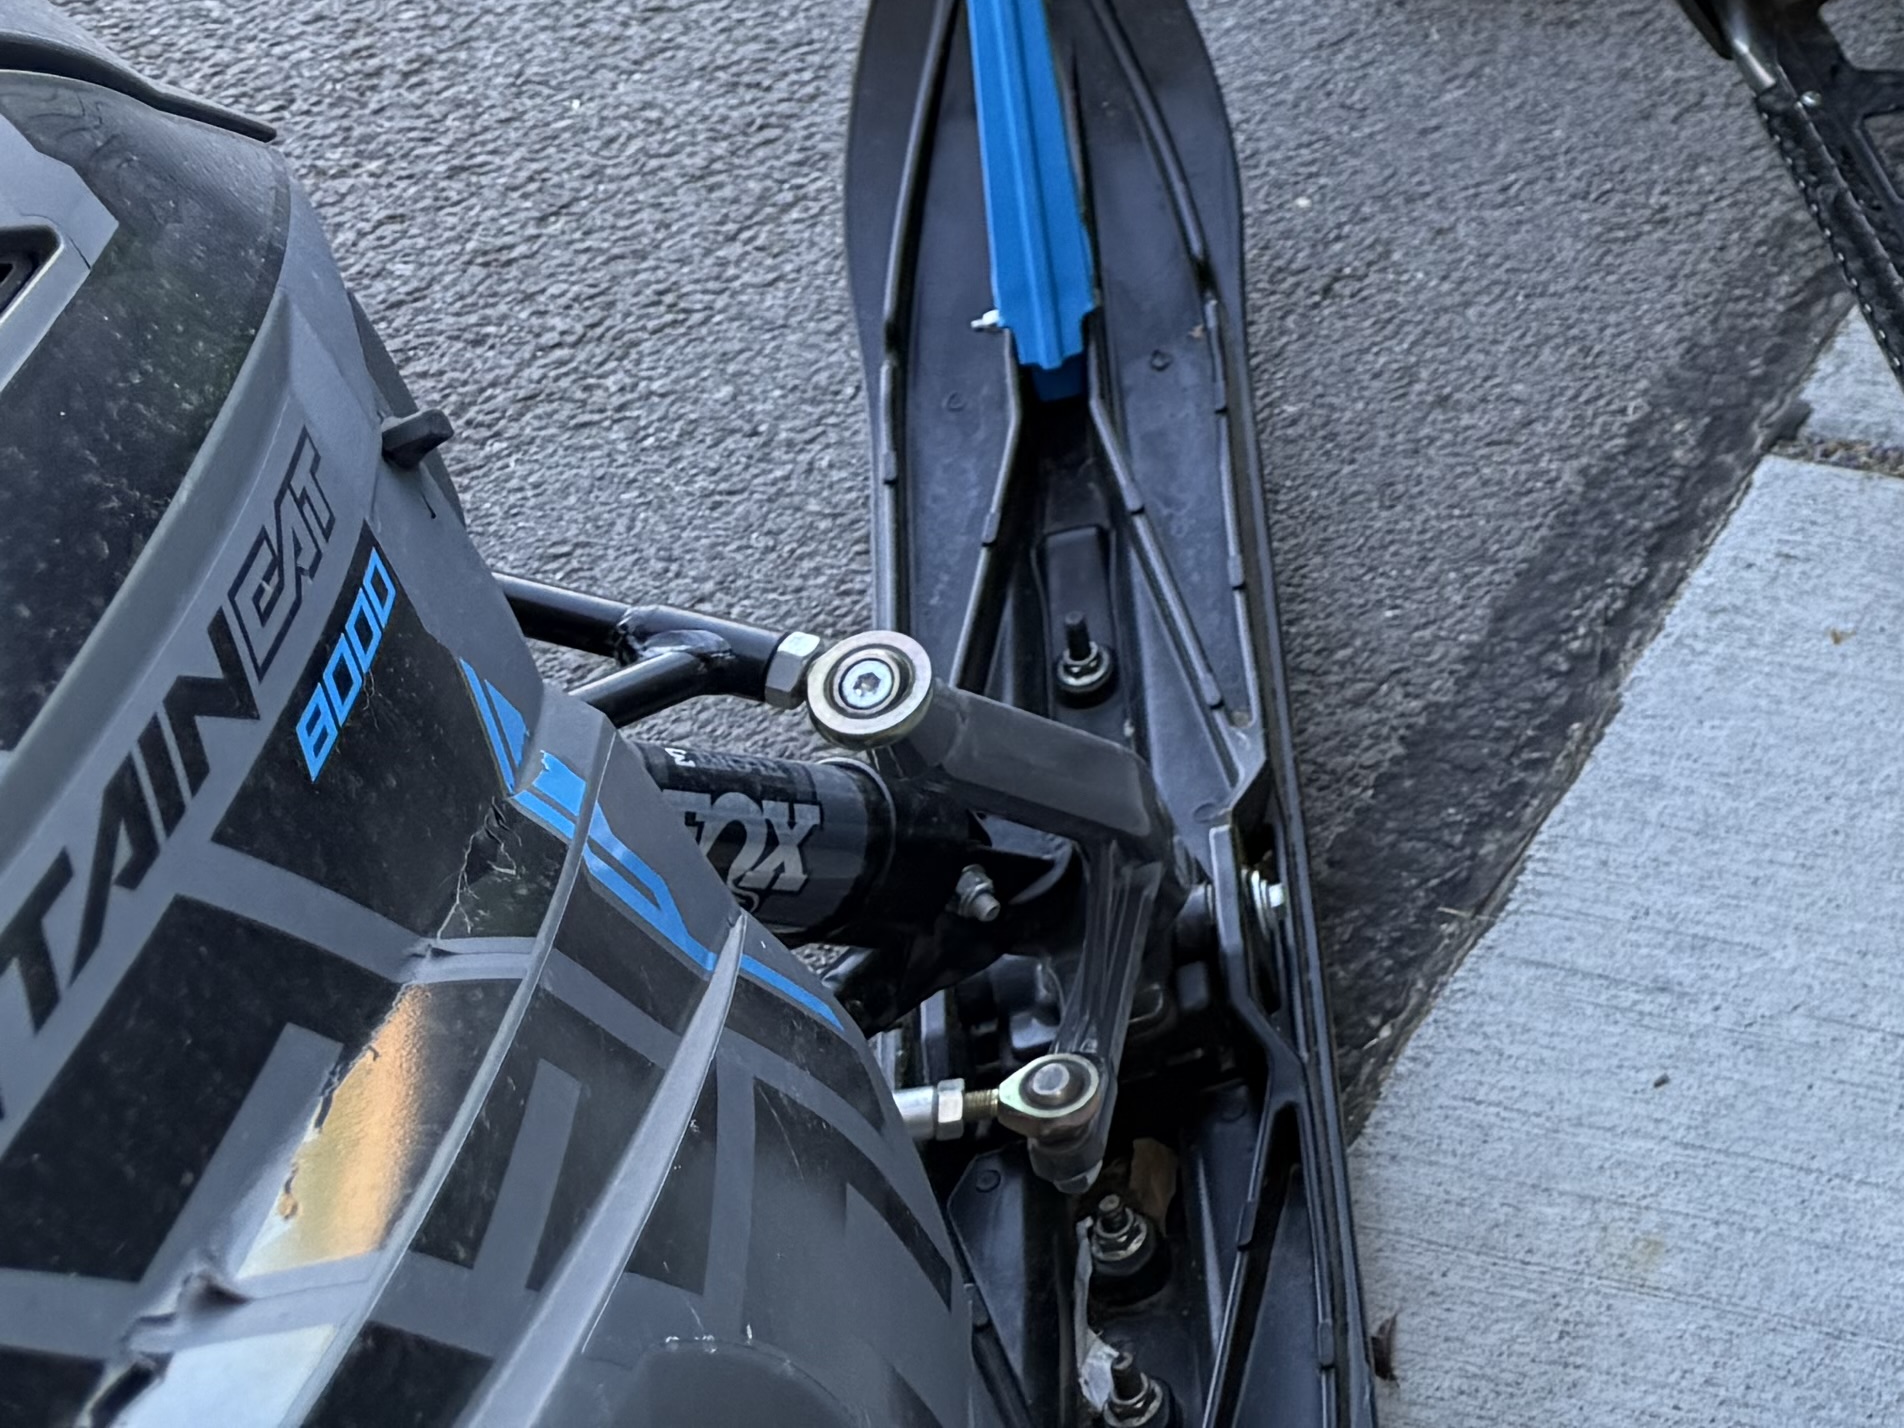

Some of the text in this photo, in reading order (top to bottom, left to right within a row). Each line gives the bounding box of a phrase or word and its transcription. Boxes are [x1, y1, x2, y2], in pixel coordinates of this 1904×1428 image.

[0, 424, 336, 1036] TAINCAT
[296, 546, 397, 784] 8000
[660, 790, 822, 912] FOX
